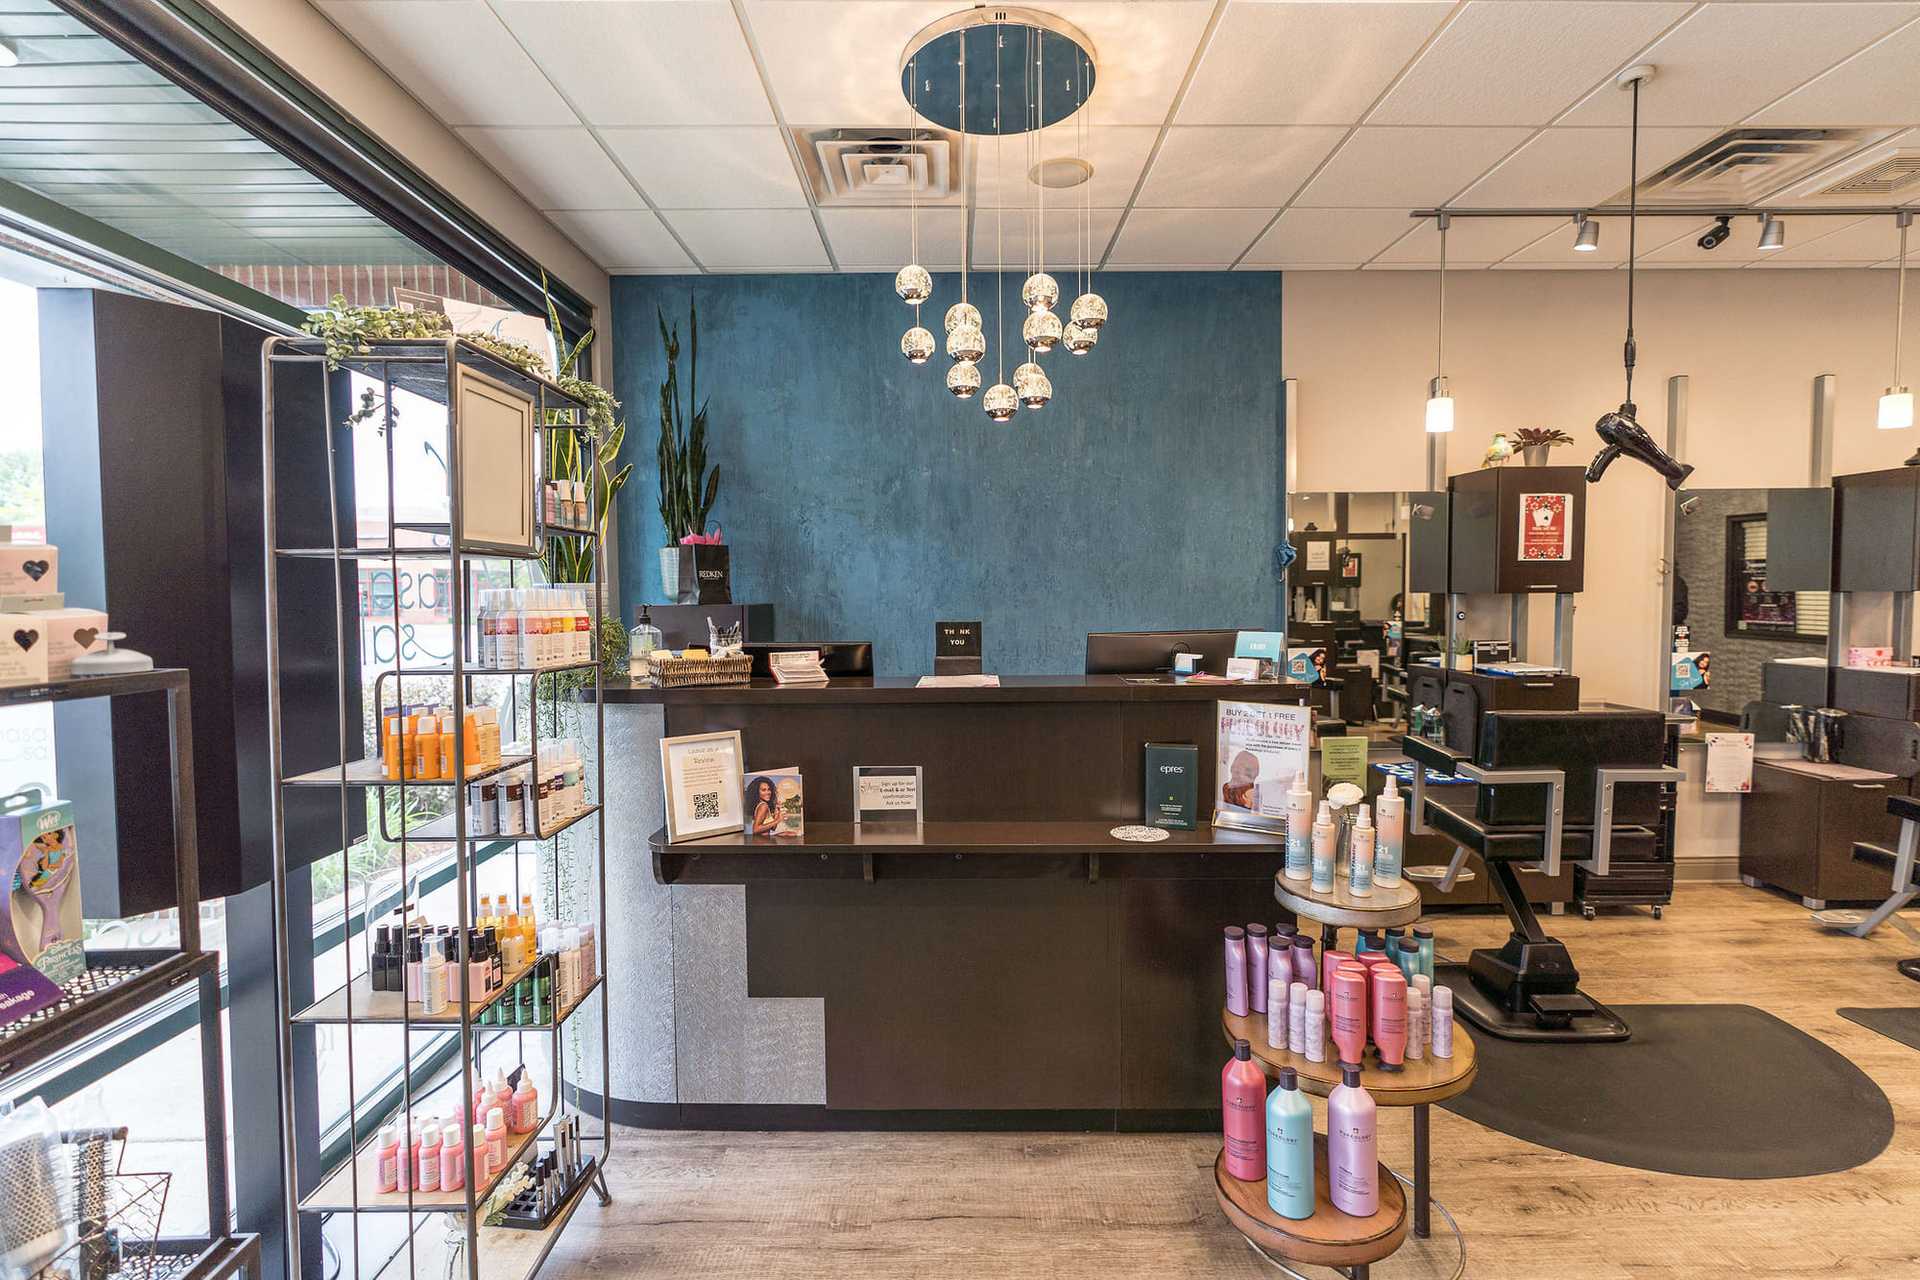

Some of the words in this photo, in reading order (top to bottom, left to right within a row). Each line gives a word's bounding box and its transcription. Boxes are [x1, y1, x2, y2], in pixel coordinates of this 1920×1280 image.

[698, 570, 723, 578] REDKEN
[1226, 708, 1242, 717] BUY
[1274, 712, 1296, 721] FREE
[1160, 765, 1183, 774] epres
[1378, 845, 1388, 854] 21
